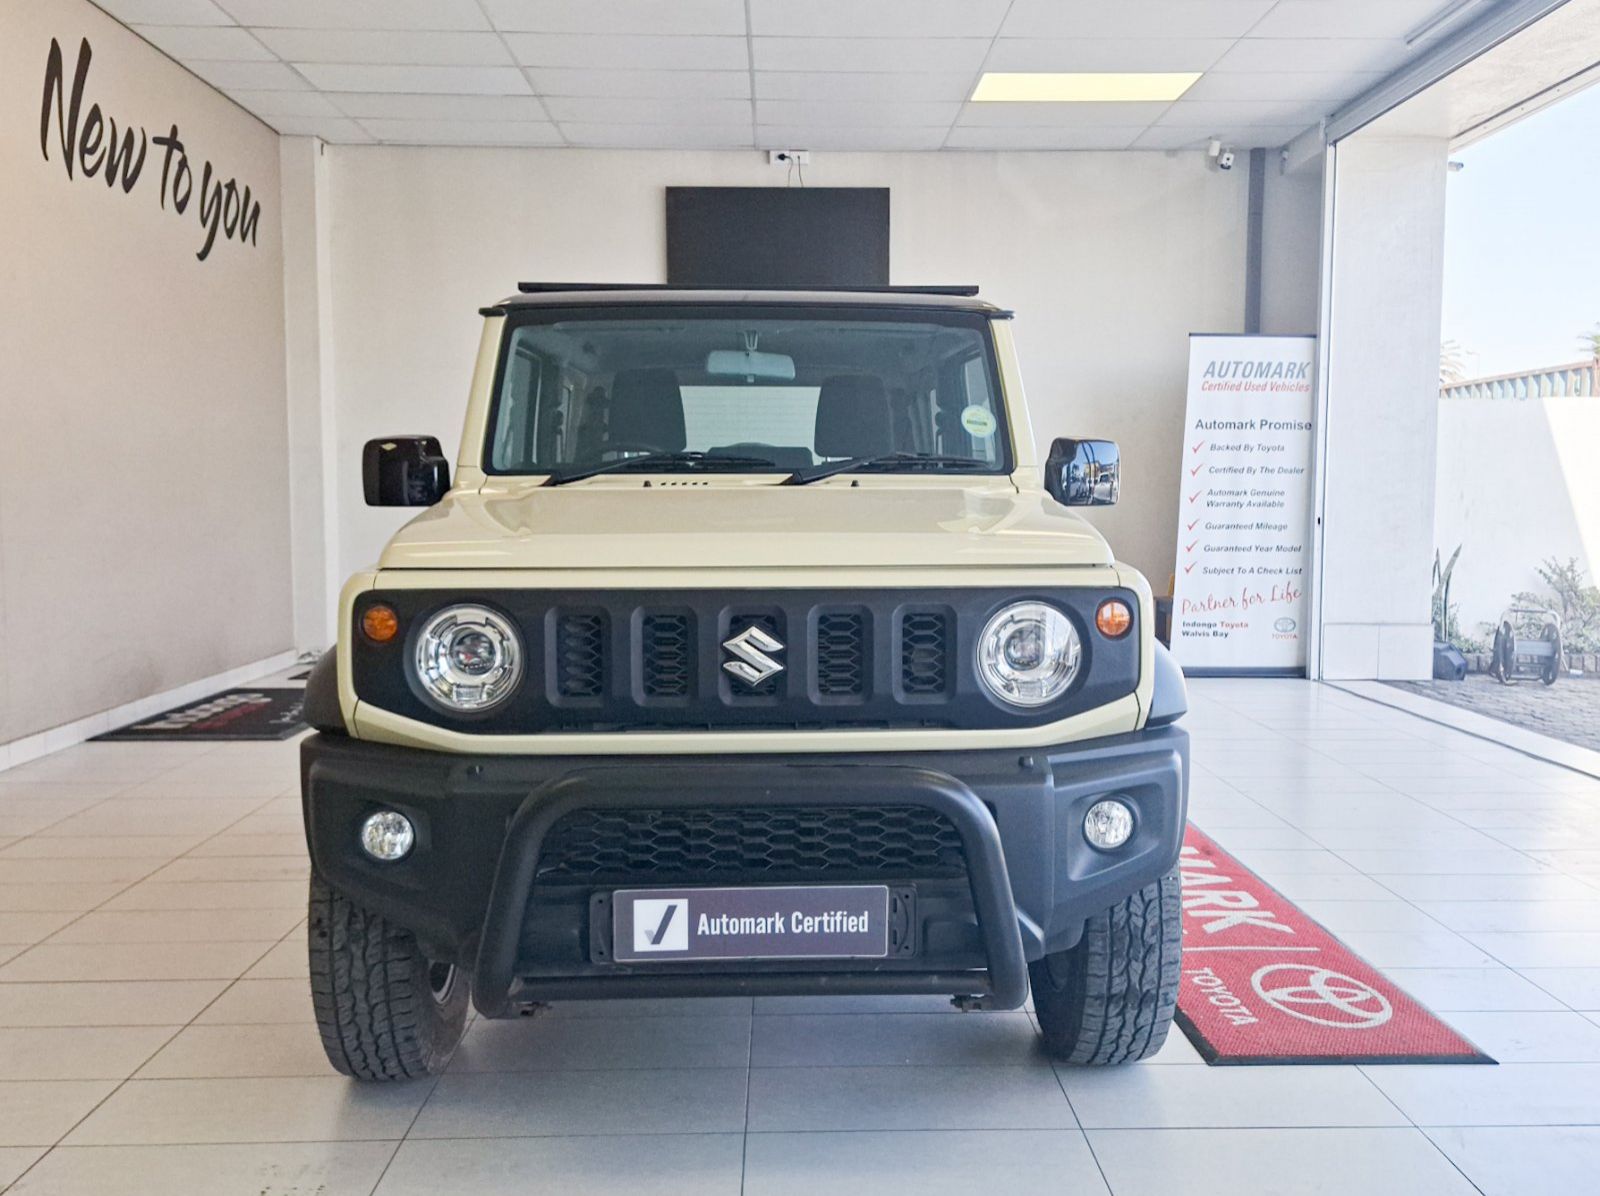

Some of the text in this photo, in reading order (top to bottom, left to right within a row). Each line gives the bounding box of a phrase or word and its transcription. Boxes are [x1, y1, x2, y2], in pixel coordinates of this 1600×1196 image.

[41, 37, 260, 261] New to you
[1203, 360, 1311, 379] AUTOMARK
[1201, 380, 1311, 393] Certified Used Vehicles
[1195, 419, 1313, 431] Automark Promise
[1210, 443, 1285, 454] Backed By Toyota
[1208, 466, 1304, 475] Certified By The Dealer
[1207, 488, 1285, 497] Automark Genuine
[1206, 500, 1285, 510] Warranty Available
[1205, 521, 1288, 532] Guaranteed Mileage
[1203, 544, 1302, 553] Guaranteed Year Model
[1202, 566, 1234, 576] Subject
[1257, 567, 1283, 575] Check
[1285, 567, 1303, 575] List
[1182, 580, 1302, 615] Partner for Life
[1220, 621, 1249, 630] Toyota
[1212, 630, 1229, 639] Bay
[697, 911, 869, 936] Automark Certified
[1183, 966, 1259, 1026] TOYOTA
